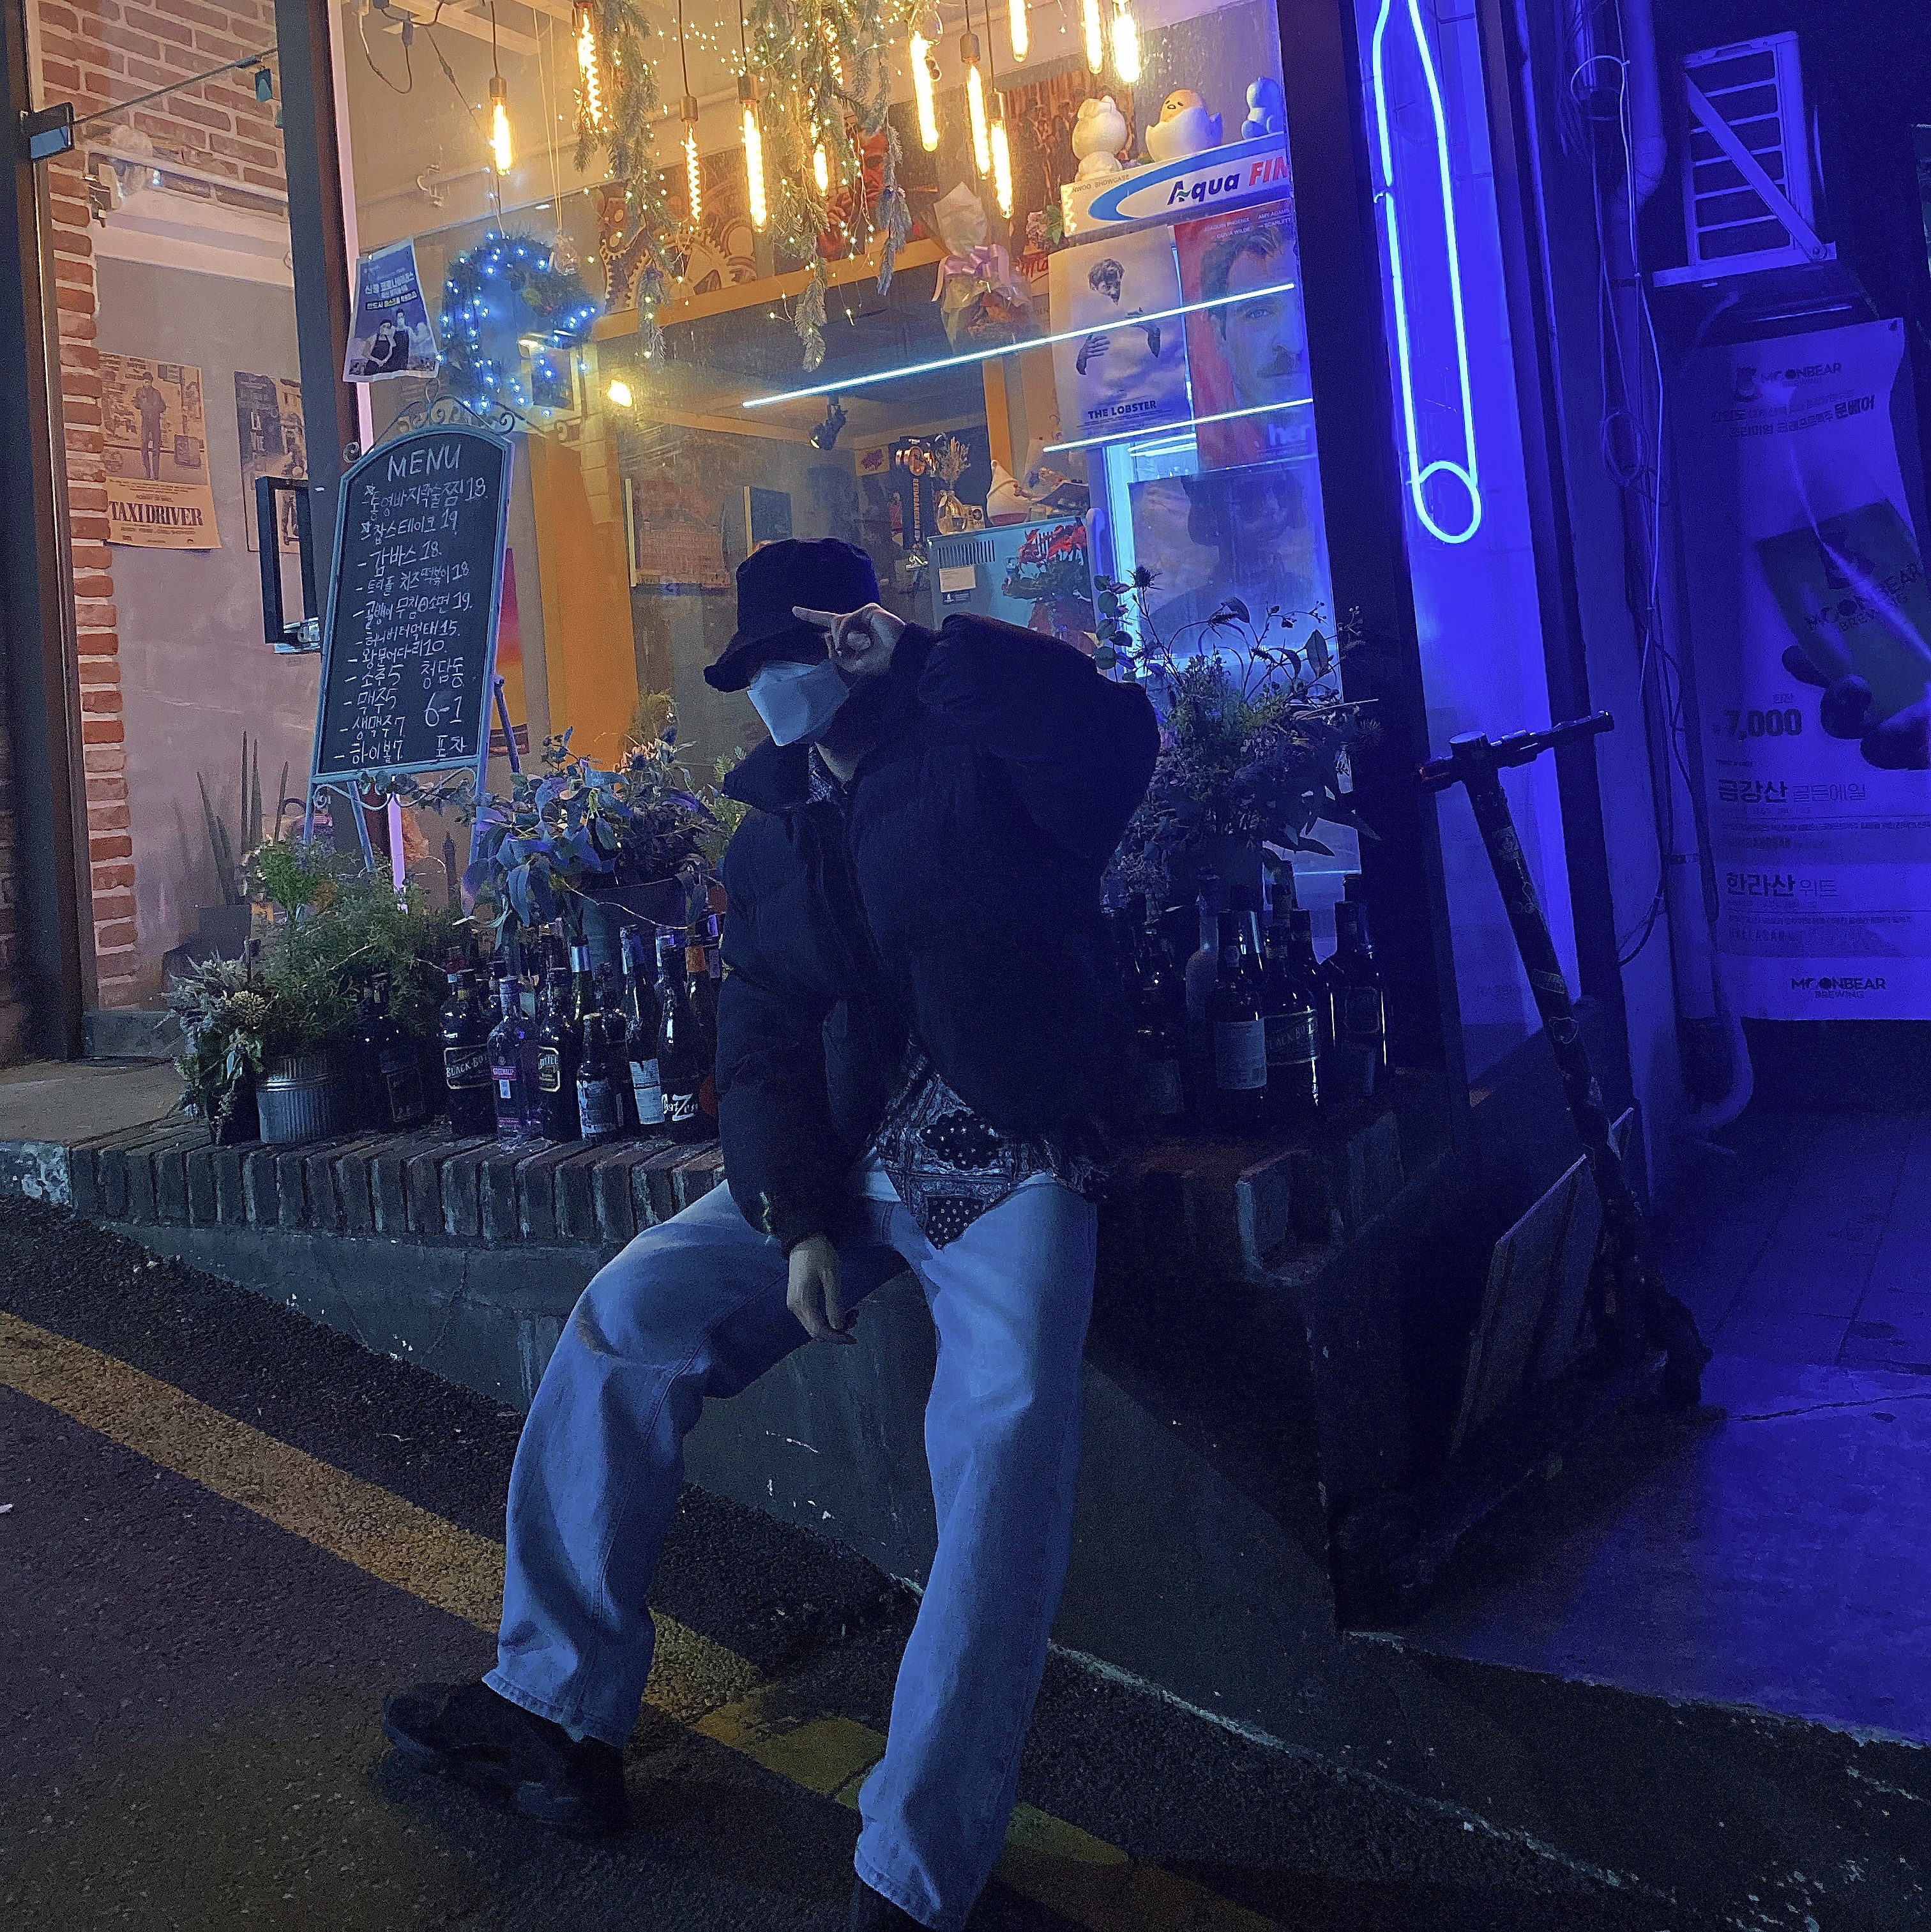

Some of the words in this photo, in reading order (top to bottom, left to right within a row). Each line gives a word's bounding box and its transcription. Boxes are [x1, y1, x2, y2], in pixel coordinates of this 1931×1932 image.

[1167, 172, 1241, 206] Aqua
[1087, 408, 1109, 420] THE
[1111, 400, 1157, 416] LOBSTER
[1268, 422, 1311, 446] her
[387, 443, 461, 482] MENU
[109, 500, 144, 523] TAXI
[145, 503, 204, 526] DRIVER
[420, 656, 464, 690] 청담동
[423, 691, 463, 727] 6-1
[435, 734, 467, 757] 포차
[1718, 779, 1789, 804] 금강산
[1792, 782, 1867, 803] 골든에일
[1725, 871, 1796, 897] 한라산
[1799, 878, 1840, 899] 위트
[446, 1061, 472, 1078] BLACK
